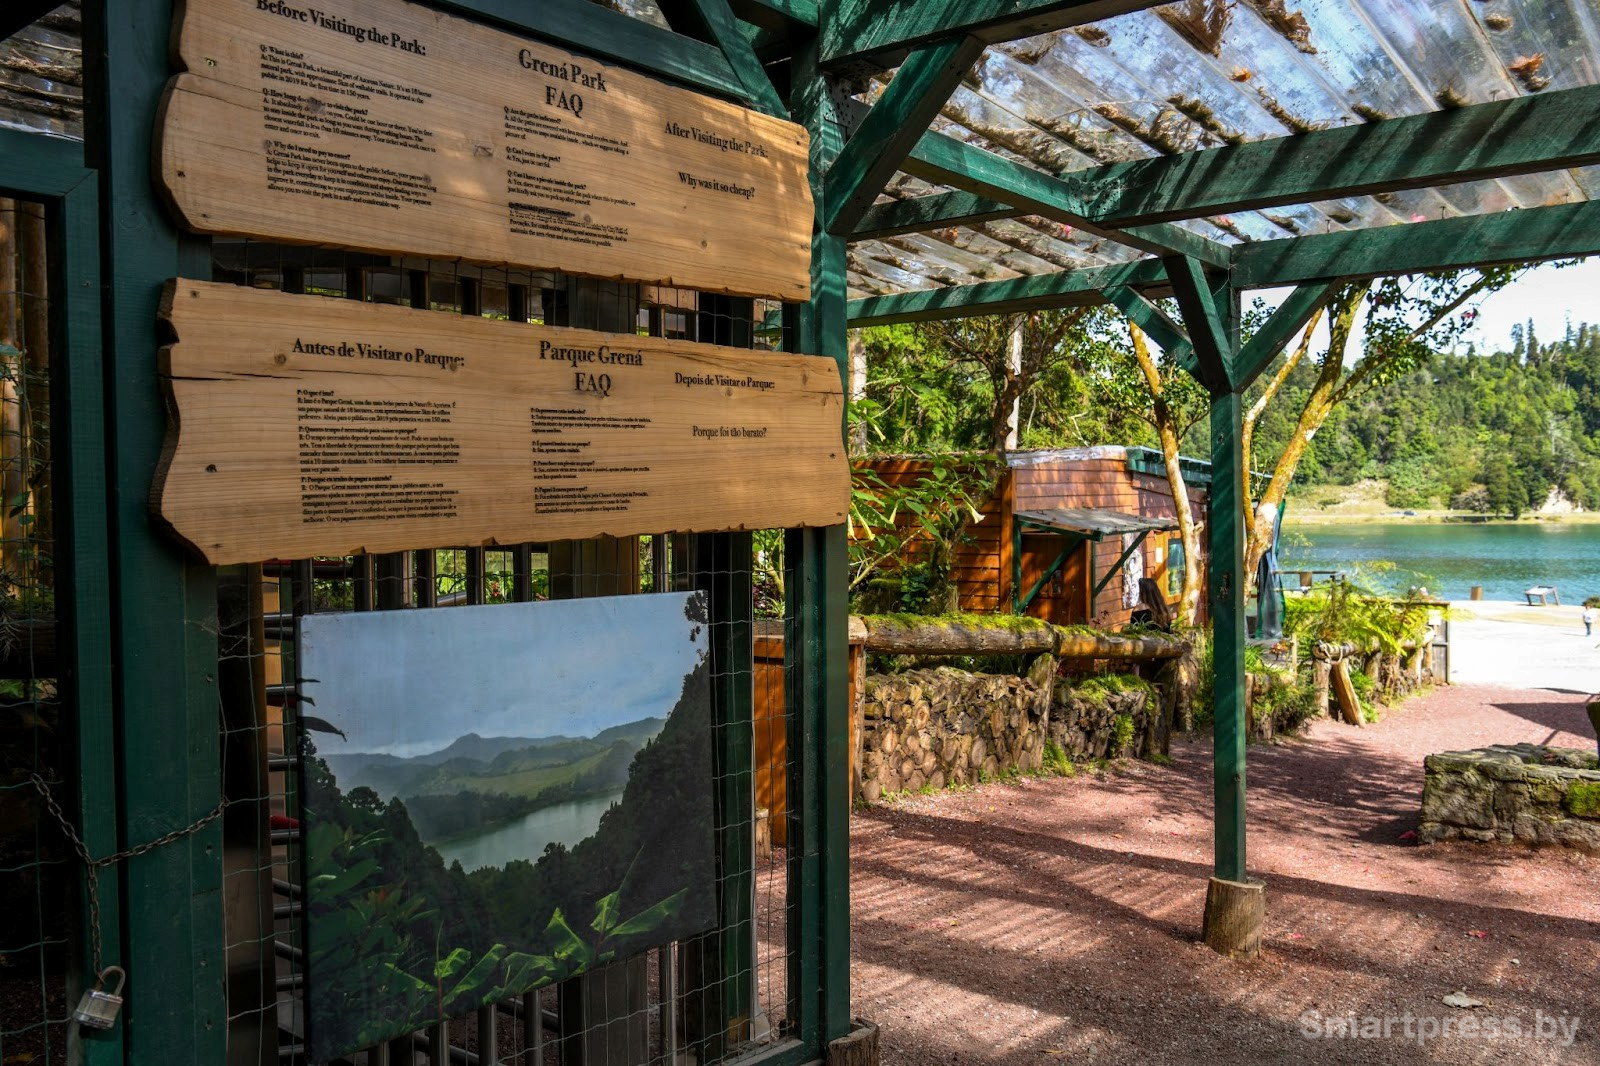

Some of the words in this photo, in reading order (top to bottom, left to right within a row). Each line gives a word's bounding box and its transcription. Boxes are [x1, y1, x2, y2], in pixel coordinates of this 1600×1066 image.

[256, 0, 308, 22] Before
[308, 8, 366, 42] Visiting
[367, 28, 388, 45] the
[390, 33, 426, 56] Park:
[518, 48, 568, 80] Grená
[570, 64, 608, 92] Park
[545, 86, 583, 118] FAQ
[664, 121, 690, 138] After
[691, 127, 728, 152] Visiting
[730, 138, 744, 152] the
[744, 141, 768, 158] Park:
[678, 172, 697, 189] Why
[700, 180, 712, 190] was
[714, 179, 720, 190] it
[720, 184, 728, 192] so
[730, 184, 755, 199] cheap?
[292, 338, 335, 356] Antes
[338, 342, 354, 357] de
[356, 343, 402, 361] Visitar
[404, 352, 413, 362] o
[539, 340, 595, 368] Parque
[598, 346, 643, 366] Grená
[574, 372, 612, 396] FAQ
[675, 372, 704, 387] Depois
[705, 375, 714, 385] de
[715, 375, 740, 387] Visitar
[747, 377, 775, 391] Parque:
[692, 426, 718, 440] Porque
[720, 426, 729, 436] foi
[730, 428, 741, 437] tão
[742, 427, 767, 437] barato?
